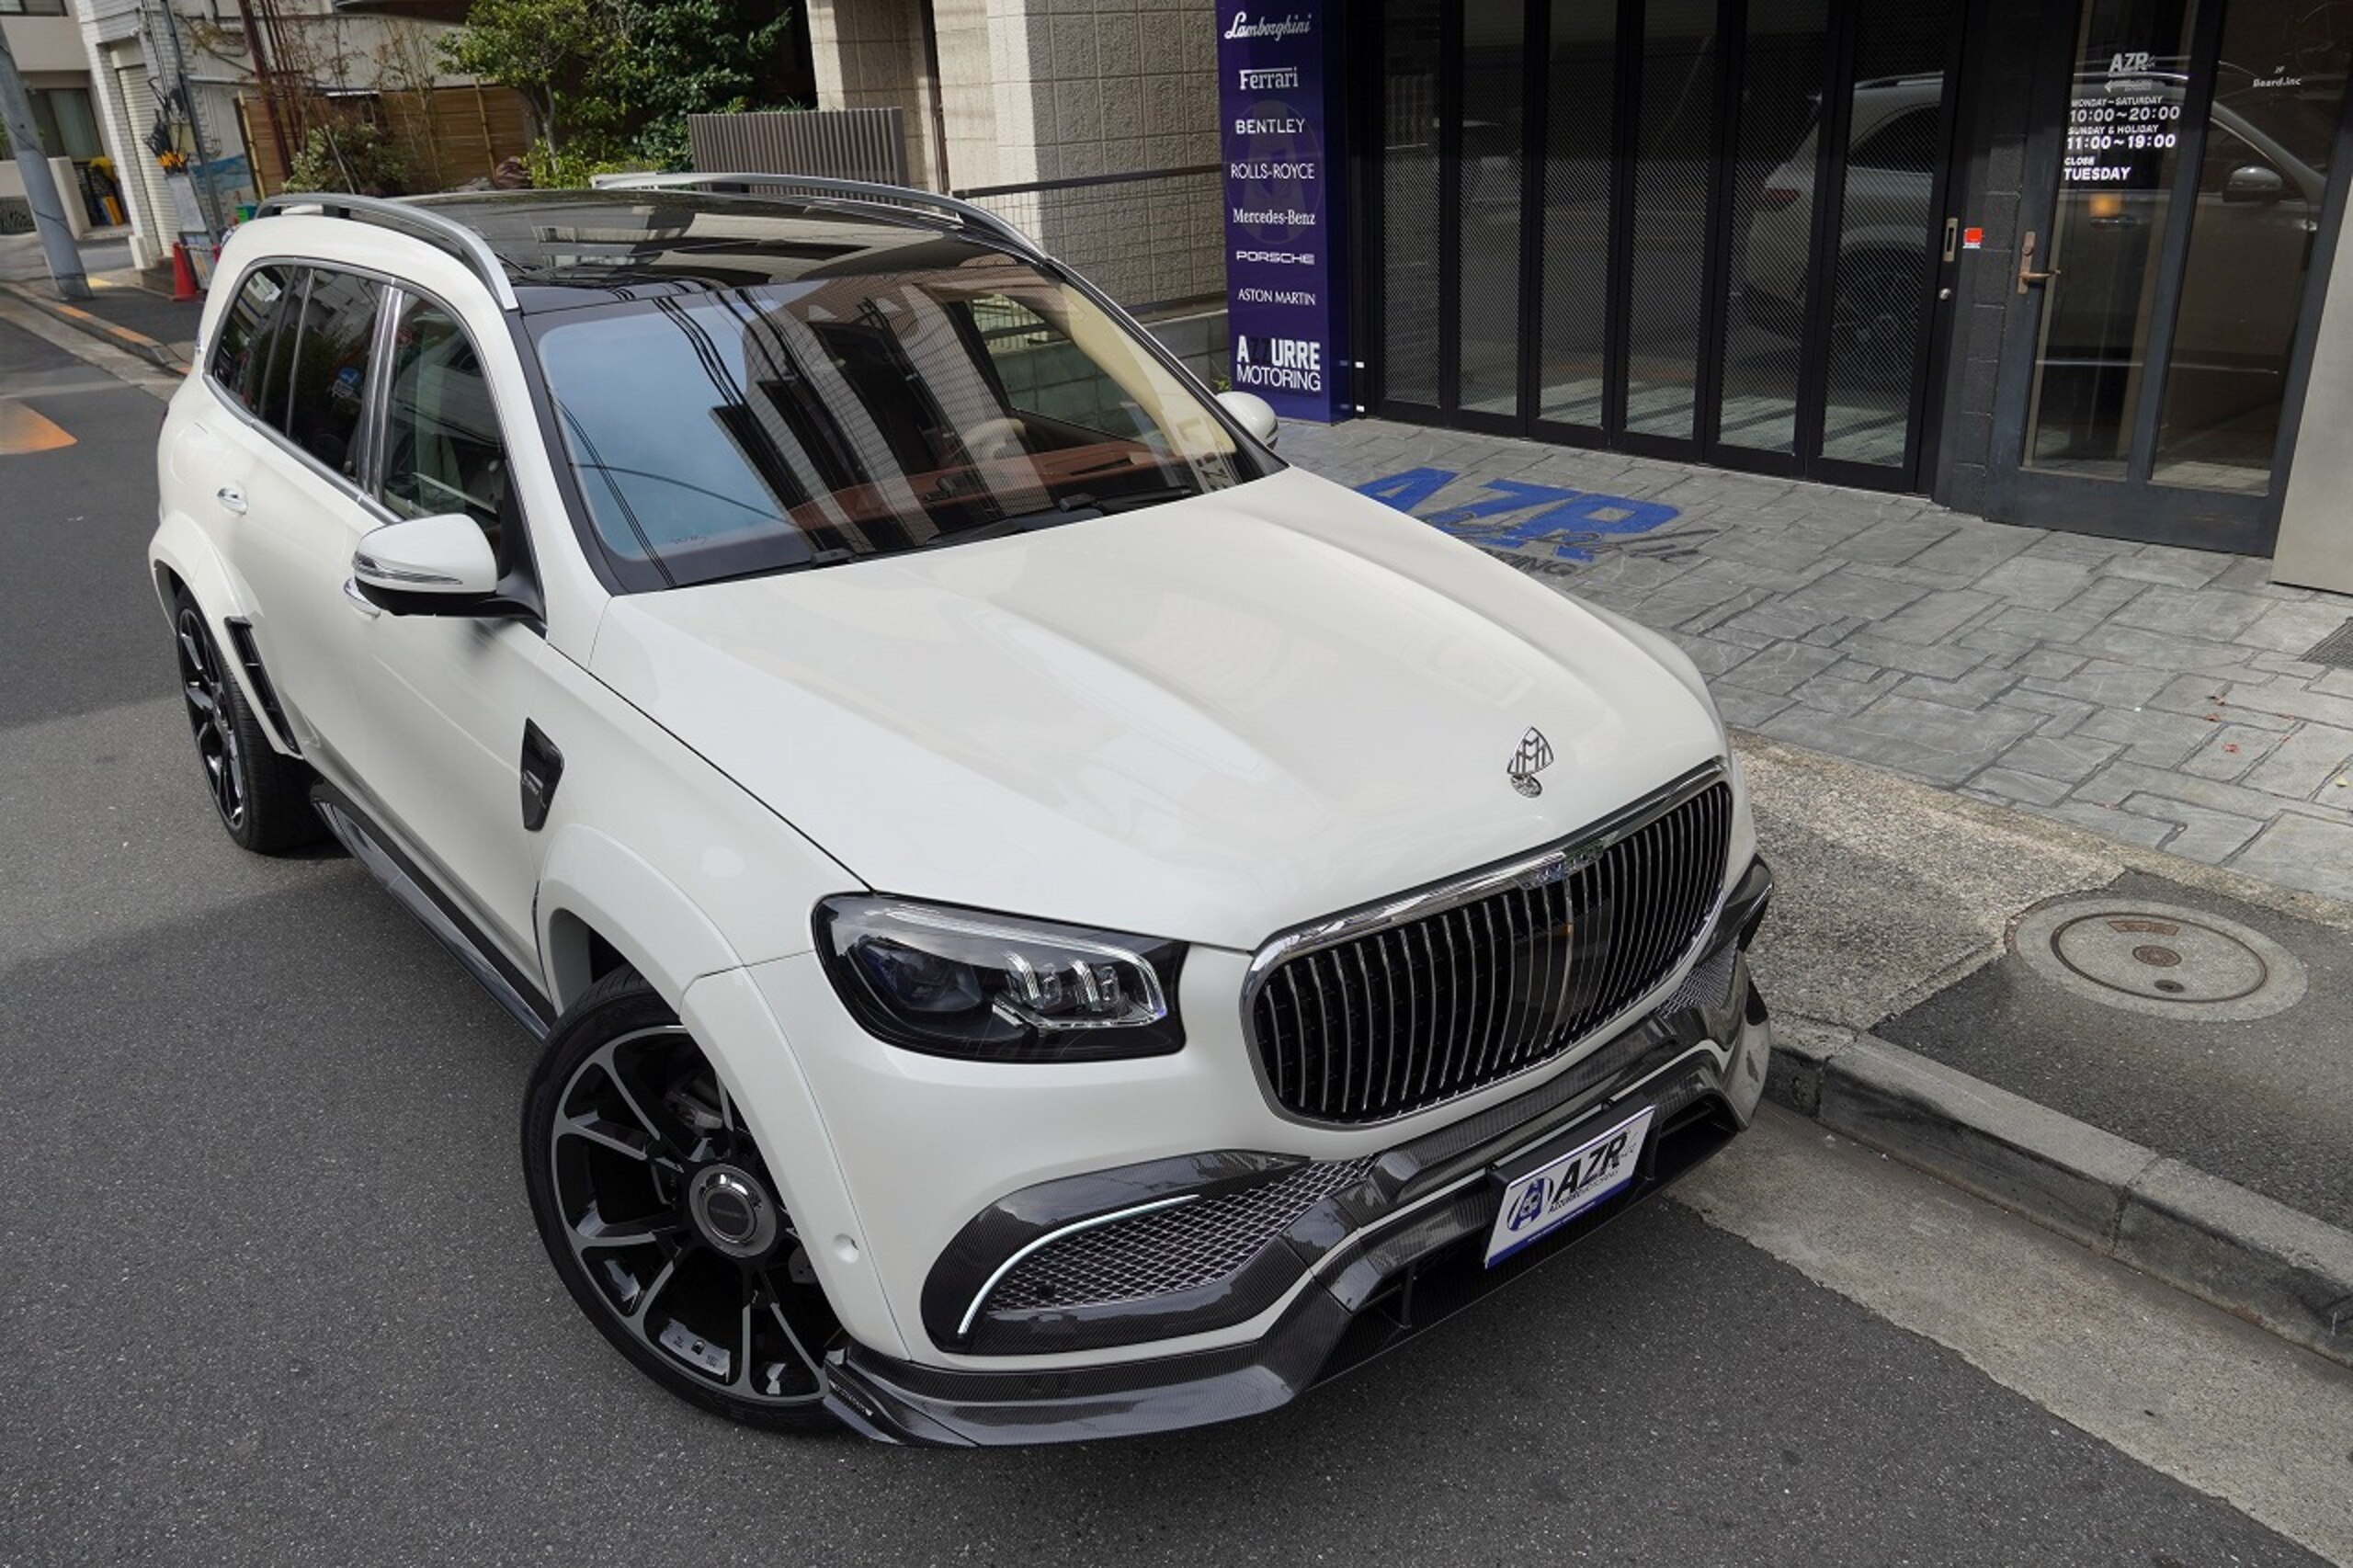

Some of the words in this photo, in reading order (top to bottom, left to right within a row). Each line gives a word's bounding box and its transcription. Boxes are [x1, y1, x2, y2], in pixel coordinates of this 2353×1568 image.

[1224, 11, 1312, 41] Lamborghini
[2108, 51, 2149, 73] AZR
[1239, 66, 1299, 91] Ferrari
[1234, 118, 1305, 134] BENTLEY
[2067, 126, 2105, 135] SUNDAY
[2117, 124, 2159, 134] HOLIDAY
[1231, 163, 1315, 179] ROLLS-ROYCE
[2063, 166, 2131, 181] TUESDAY
[1233, 208, 1315, 225] Mercedes-Benz
[1236, 250, 1315, 265] PORSCHE
[1238, 288, 1273, 302] ASTON
[1275, 290, 1316, 305] MARTIN
[1236, 364, 1322, 392] MOTORING
[1551, 1131, 1628, 1205] AZR
